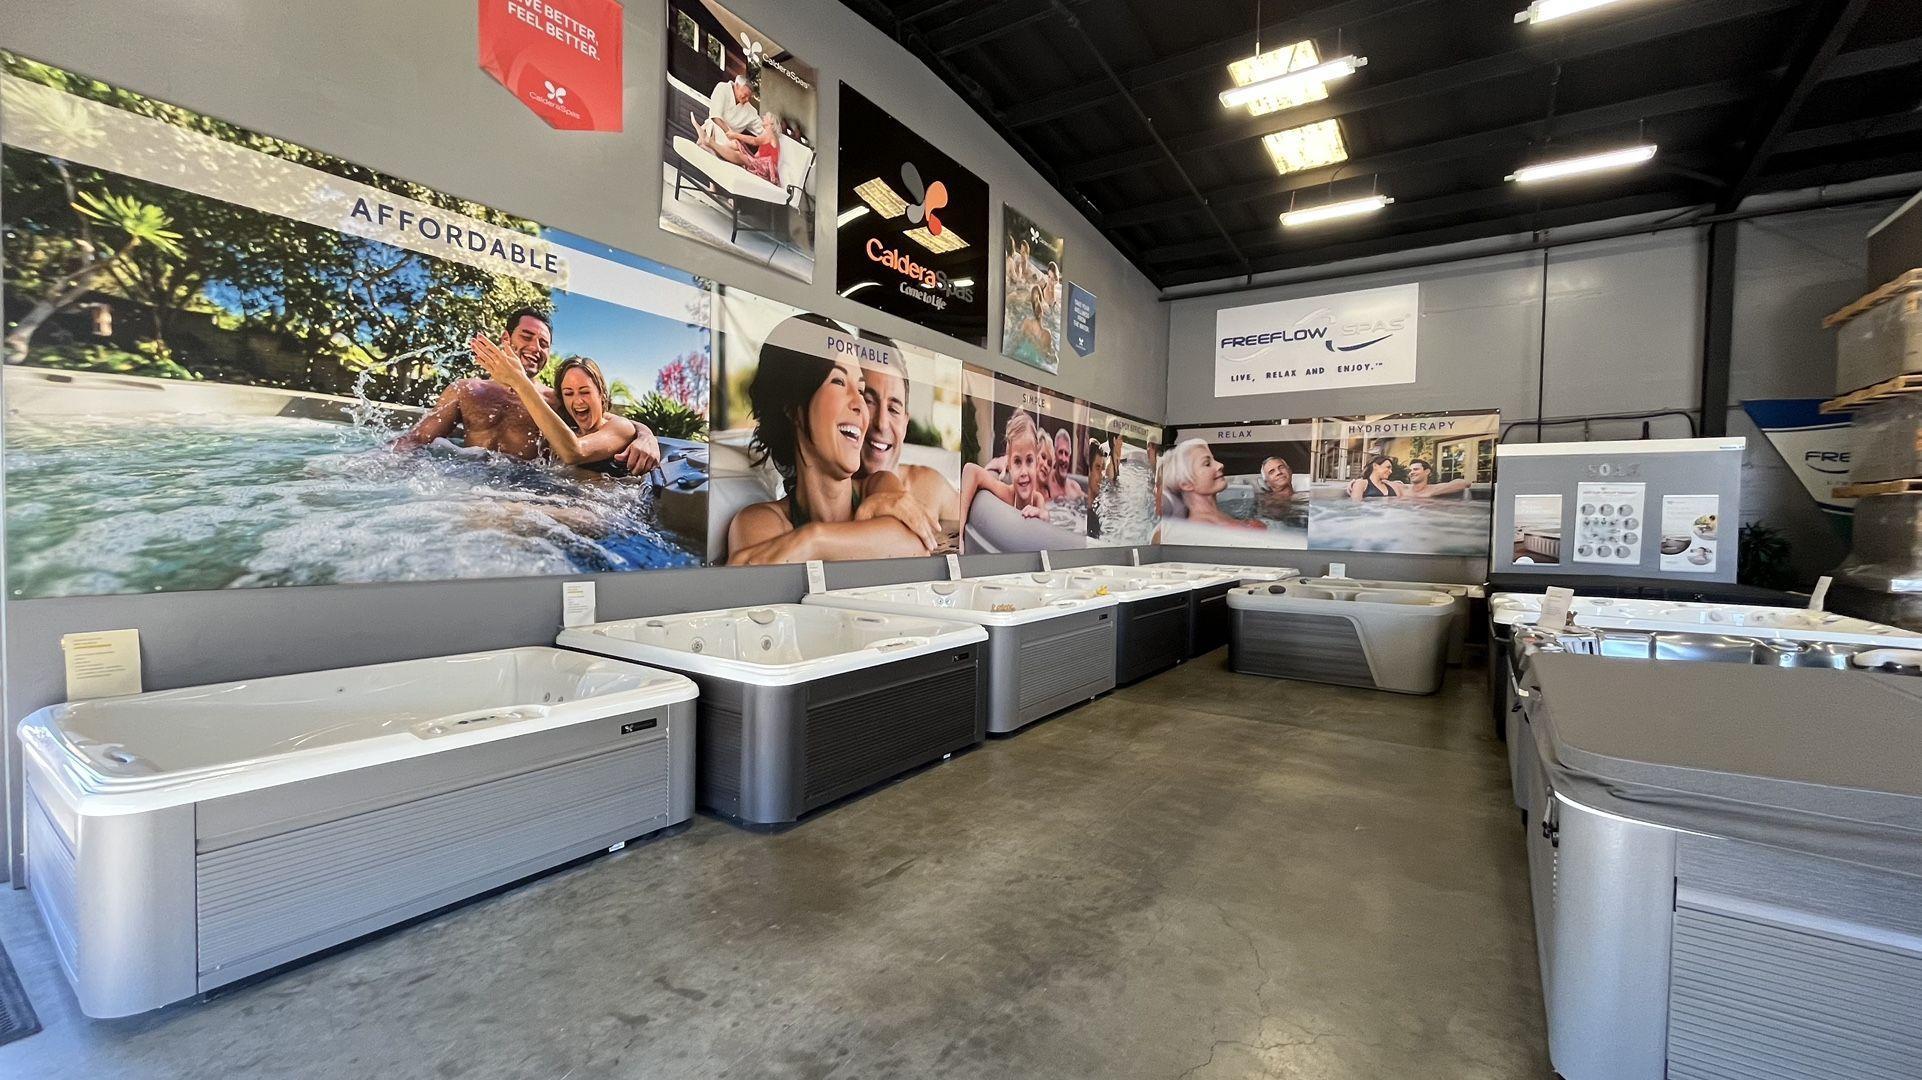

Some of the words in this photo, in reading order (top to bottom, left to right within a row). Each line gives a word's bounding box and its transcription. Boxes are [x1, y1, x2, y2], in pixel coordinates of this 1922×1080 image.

[507, 1, 544, 31] FEEL
[546, 21, 600, 61] BETTER.
[544, 4, 599, 46] BETTER,
[529, 91, 580, 120] CalderaSpas
[350, 197, 558, 274] AFFORDABLE
[899, 281, 923, 300] Come
[922, 291, 932, 304] to
[931, 294, 948, 310] Life
[827, 336, 889, 365] PORTABLE
[1220, 326, 1328, 349] FREEFLOW
[1230, 373, 1256, 382] LIVE,
[1266, 369, 1297, 379] RELAX
[1305, 366, 1325, 376] AND
[1022, 393, 1045, 409] SIMPLE
[1217, 429, 1252, 439] RELAX
[1348, 421, 1455, 434] HYDROTHERAPY
